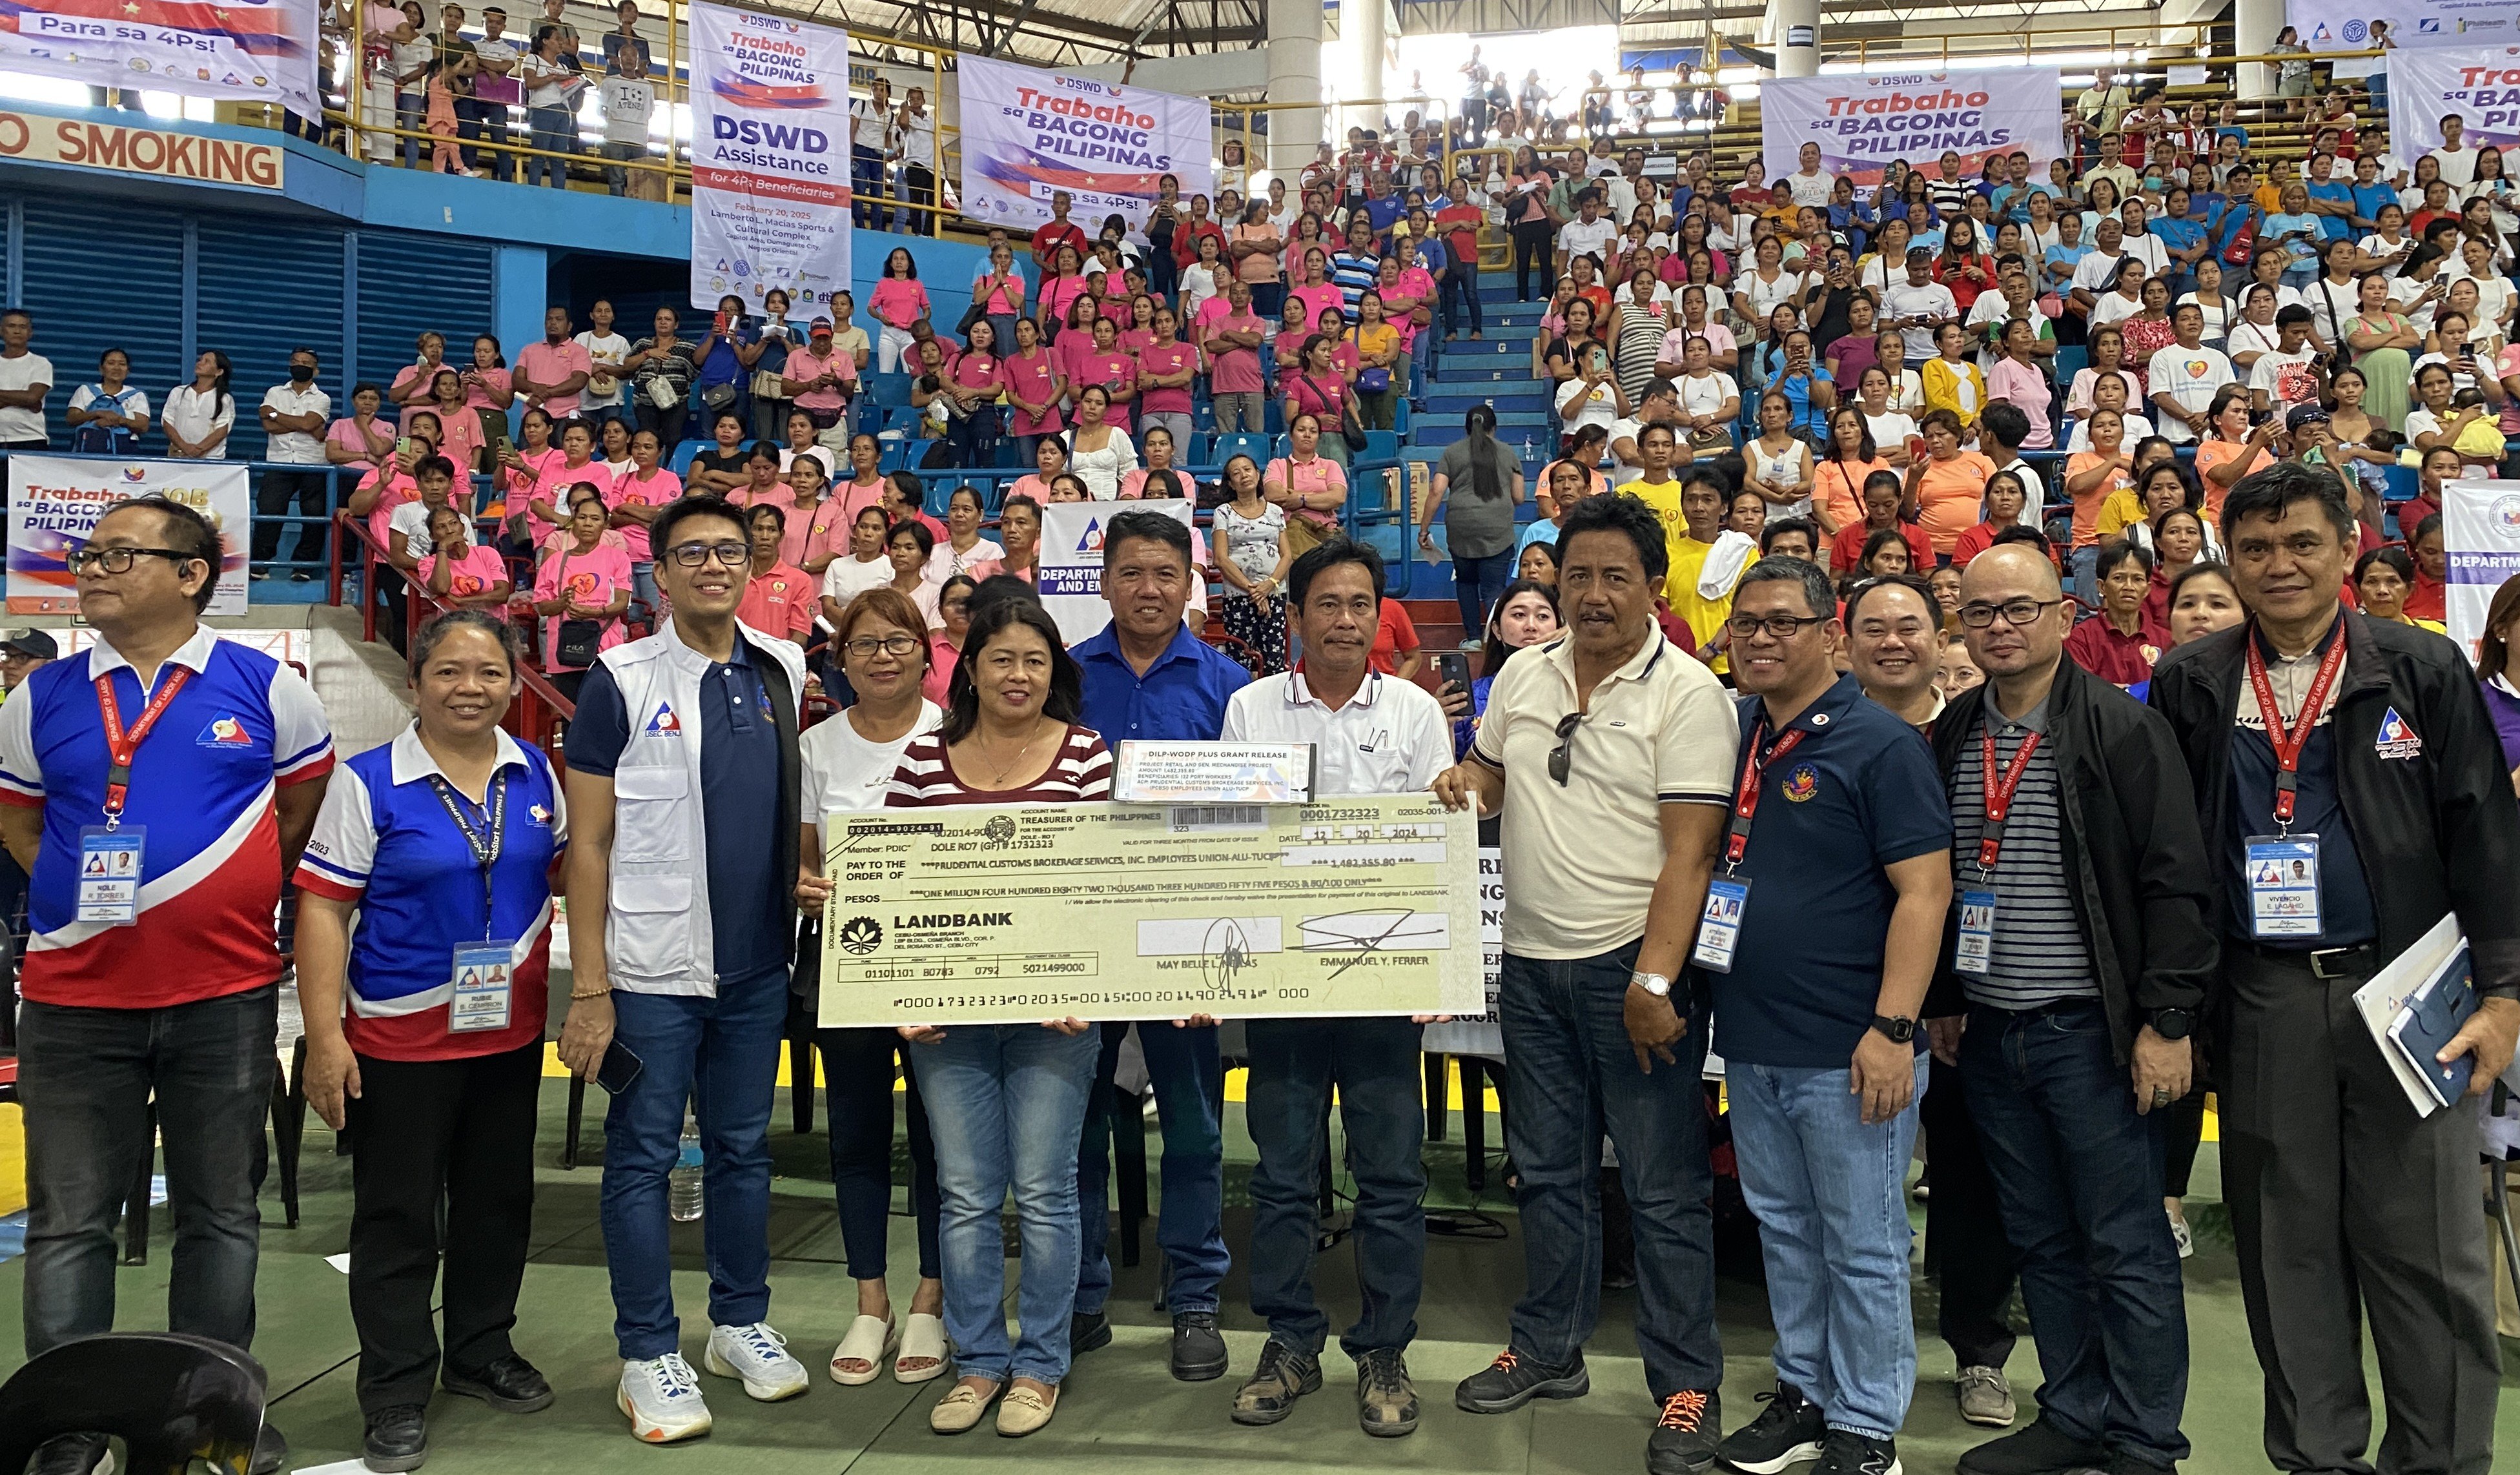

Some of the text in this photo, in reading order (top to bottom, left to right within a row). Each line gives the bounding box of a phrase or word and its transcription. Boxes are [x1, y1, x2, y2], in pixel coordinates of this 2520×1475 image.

[750, 15, 781, 30] DSWD
[40, 16, 216, 53] Para sa 4Ps!
[731, 32, 806, 56] Trabaho
[736, 48, 802, 68] BAGONG
[740, 62, 815, 83] PILIPINAS
[1883, 75, 1922, 85] DSWD
[620, 87, 629, 100] I
[1067, 78, 1101, 93] DSWD
[1826, 89, 1989, 116] Trabaho
[2443, 91, 2468, 100] sa
[1016, 86, 1155, 129] Trabaho
[1003, 107, 1149, 148] sa BAGONG
[1810, 111, 1981, 135] sa BAGONG
[713, 114, 828, 154] DSWD
[1847, 129, 2010, 154] PILIPINAS
[57, 121, 276, 186] SMOKING
[714, 145, 828, 175] Assistance
[1035, 134, 1171, 170] PILIPINAS
[710, 172, 728, 183] for
[756, 179, 835, 199] Beneficiaries
[1082, 194, 1138, 210] sa 4Ps!
[735, 203, 773, 216] February
[790, 211, 811, 219] 2025
[711, 210, 754, 222] Lamberto
[766, 219, 795, 229] Macias
[798, 223, 826, 233] Sports
[735, 225, 810, 241] Cultural Complex
[1498, 343, 1506, 353] G
[26, 485, 130, 500] Trabaho
[1056, 581, 1084, 592] AND
[1431, 656, 1440, 671] F
[129, 682, 176, 742] DEPARTMENT OF LABOR
[2256, 676, 2282, 744] DEPARTMENT OF LABOR
[2293, 662, 2333, 745] DEPARTMENT OF LABOR AND
[105, 707, 119, 741] DEPARTMENT
[1778, 735, 1794, 752] LABOR
[1986, 762, 1995, 798] DEPARTMENT
[2000, 760, 2021, 798] DEPARTMENT
[442, 795, 469, 829] PHILIPPINES
[494, 794, 503, 828] PHILIPPINES
[1020, 816, 1072, 824] TREASURER
[1110, 813, 1162, 821] PHILIPPINES
[1300, 809, 1379, 819] 0001732323
[849, 824, 941, 834] 002014-9024-91
[1393, 829, 1417, 838] 2024
[981, 842, 999, 851] (GF)
[1010, 840, 1053, 849] 1732323
[989, 854, 1197, 868] CUSTOMS BROKERAGE SERVICES, INC. EMPLOYEES
[846, 872, 883, 880] ORDER
[944, 888, 980, 897] MILLION
[982, 888, 1007, 896] FOUR
[1008, 886, 1050, 895] HUNDRED
[1052, 886, 1081, 894] EIGHTY
[1106, 884, 1154, 892] THOUSAND
[1184, 882, 1227, 890] HUNDRED
[845, 895, 880, 903] PESOS
[894, 912, 1013, 929] LANDBANK
[975, 967, 999, 975] 0792
[1023, 963, 1085, 973] 5021499000
[1157, 961, 1178, 970] MAY
[1182, 960, 1209, 969] BELLE
[1320, 957, 1428, 966] EMMANUEL Y. FERRER
